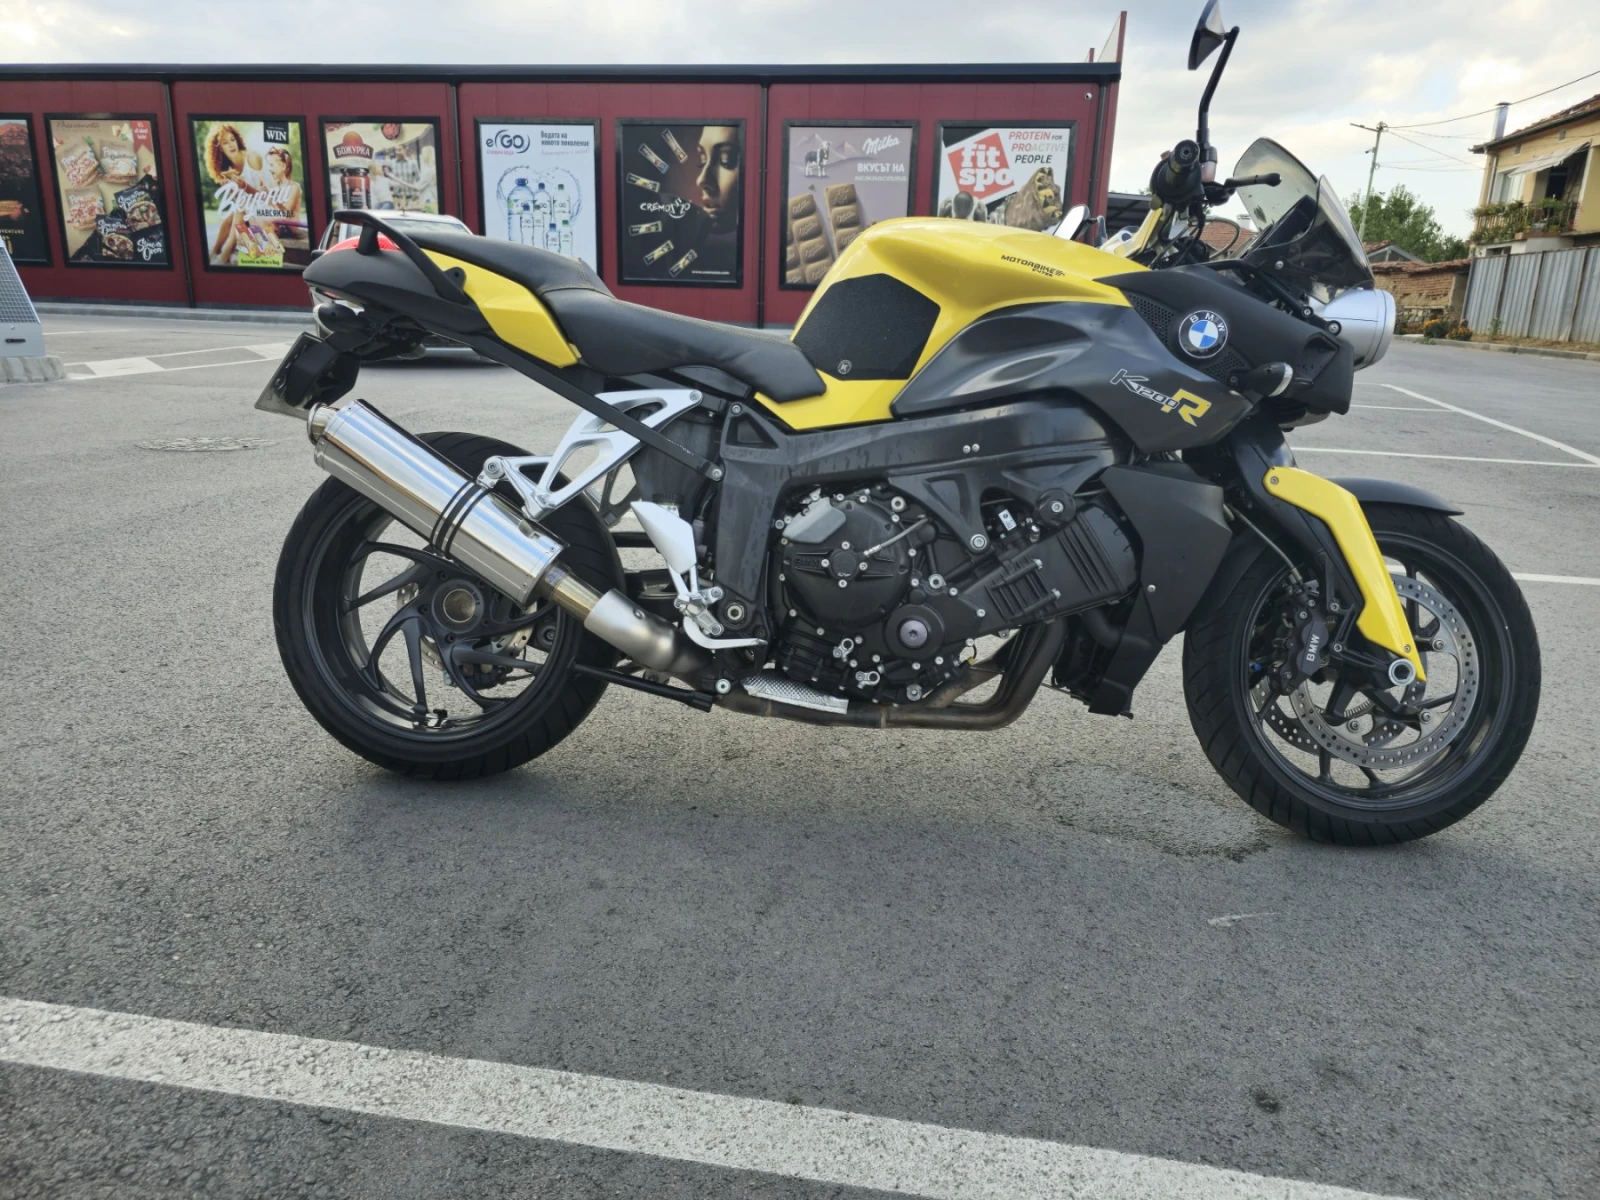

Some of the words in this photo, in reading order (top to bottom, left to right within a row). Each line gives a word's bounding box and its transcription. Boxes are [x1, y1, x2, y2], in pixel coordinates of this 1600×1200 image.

[265, 129, 287, 141] WIN
[541, 131, 560, 139] Водата
[1008, 131, 1051, 141] PROTEIN
[862, 134, 900, 155] Milka
[1011, 143, 1066, 153] PROACTIVE
[336, 145, 371, 156] БОЖУРКА
[961, 143, 1001, 168] fit
[1014, 154, 1052, 164] PEOPLE
[857, 163, 890, 173] ВКУСЪТ
[892, 163, 905, 173] НА
[256, 209, 295, 218] НАВСЯКЪДЕ
[1001, 255, 1056, 274] MOTORBIKE
[1189, 312, 1226, 332] BMW
[1306, 634, 1320, 662] BMW
